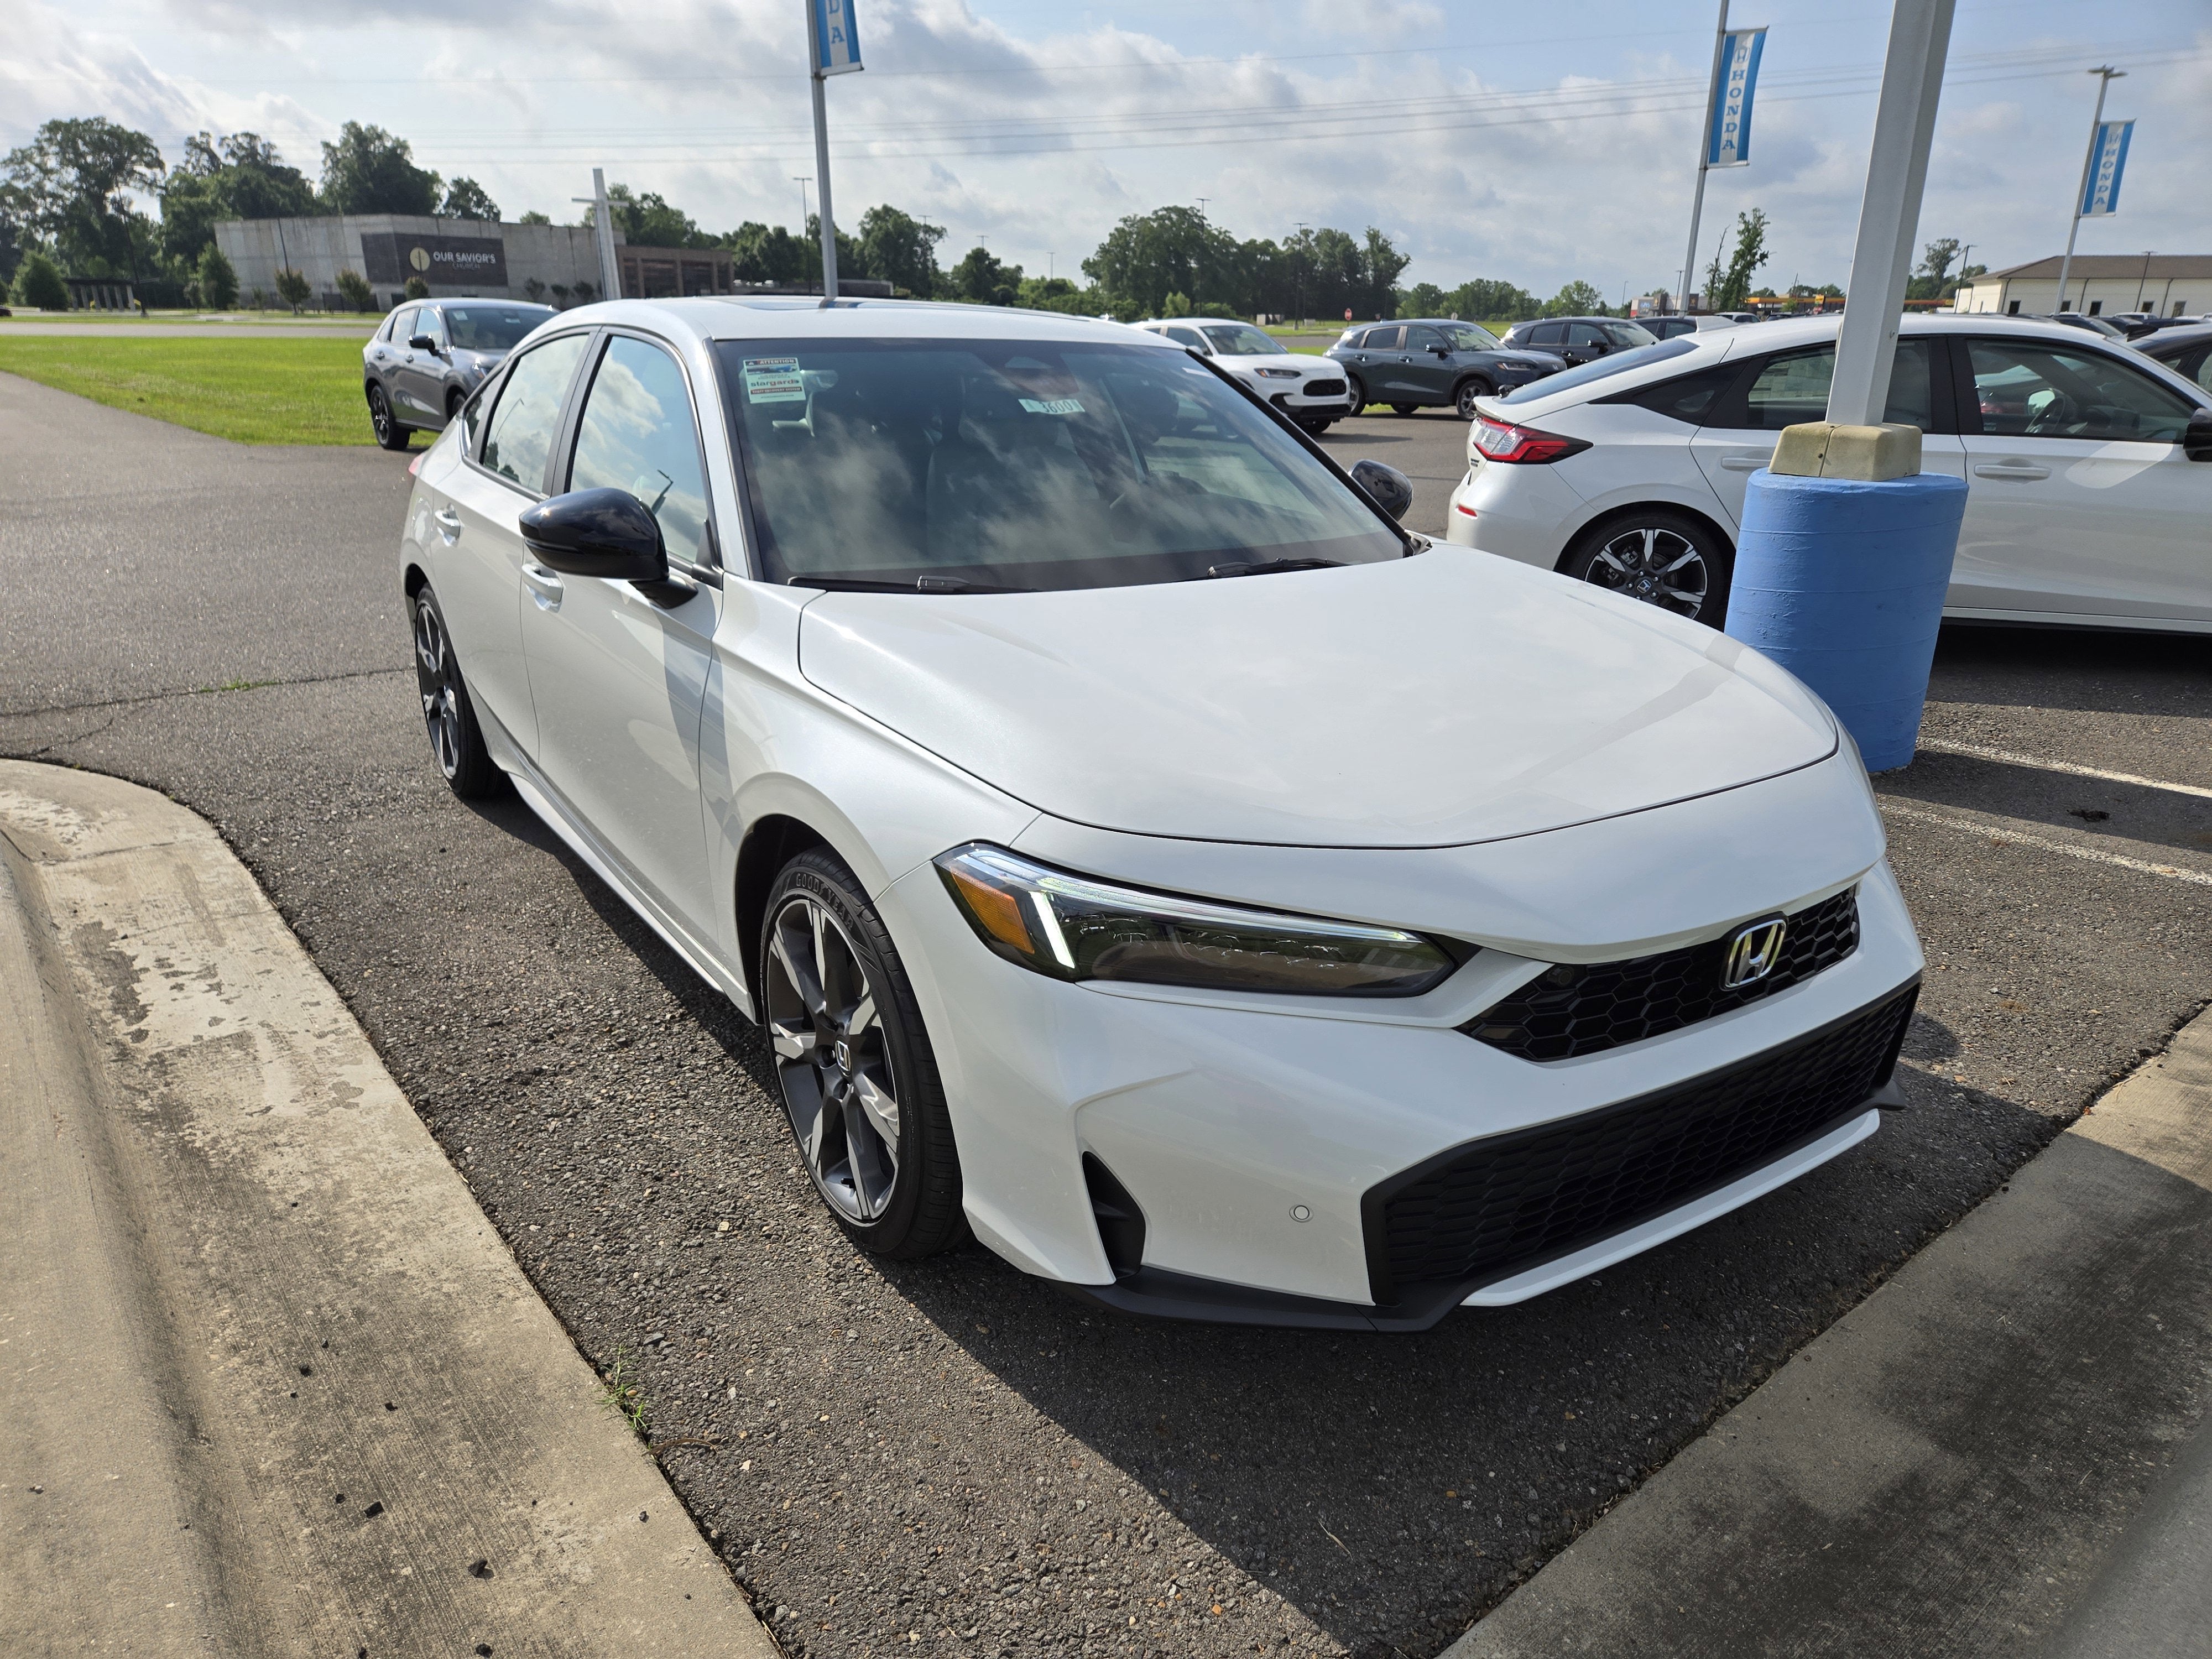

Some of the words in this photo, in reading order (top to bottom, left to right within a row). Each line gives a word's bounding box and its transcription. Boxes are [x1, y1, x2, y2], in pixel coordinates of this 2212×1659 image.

[1722, 70, 1745, 149] HONDA
[2094, 149, 2117, 205] HONDA
[433, 251, 454, 262] OUR
[456, 252, 496, 264] SAVIOR'S
[1039, 400, 1074, 413] 3600
[796, 873, 853, 931] GOODYEAR
